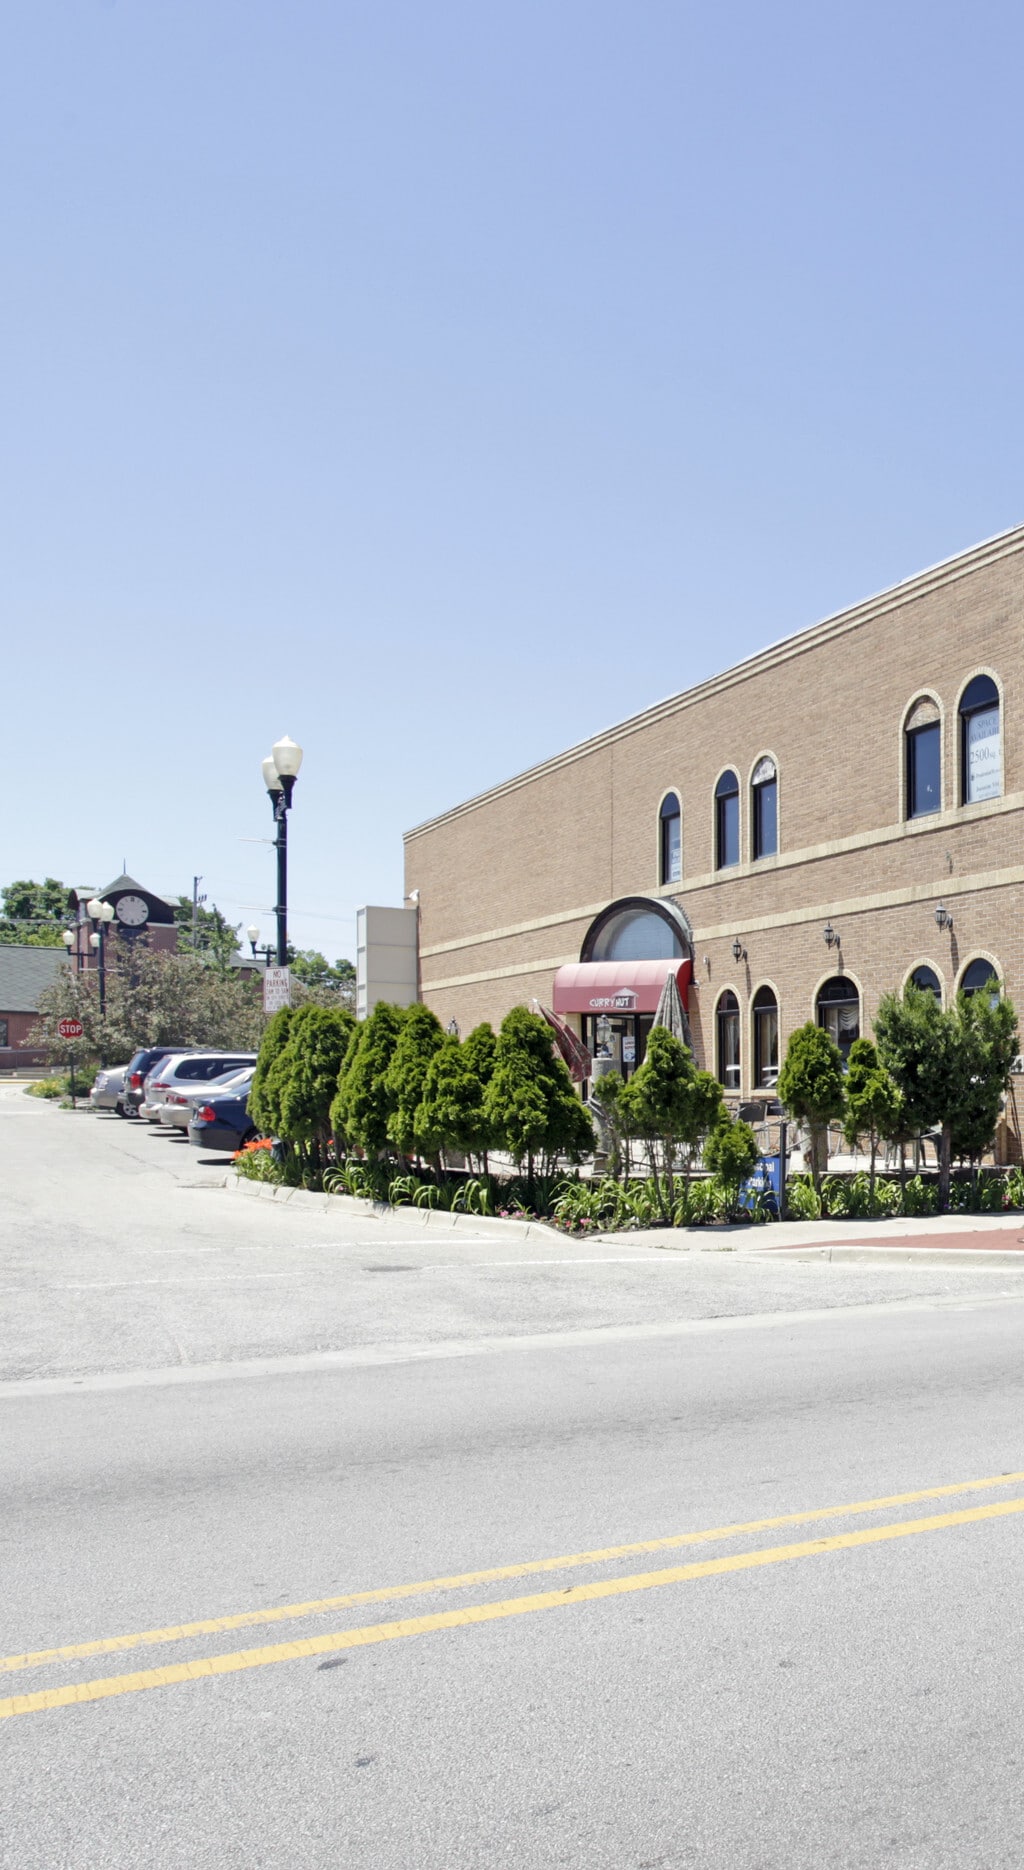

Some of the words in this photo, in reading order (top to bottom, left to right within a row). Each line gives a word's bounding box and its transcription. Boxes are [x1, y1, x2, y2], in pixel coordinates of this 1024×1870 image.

[970, 747, 989, 764] 2500
[273, 970, 281, 978] NO
[266, 979, 288, 988] PARKING
[589, 998, 615, 1007] CURRY
[615, 997, 630, 1007] HUT
[60, 1024, 82, 1034] STOP
